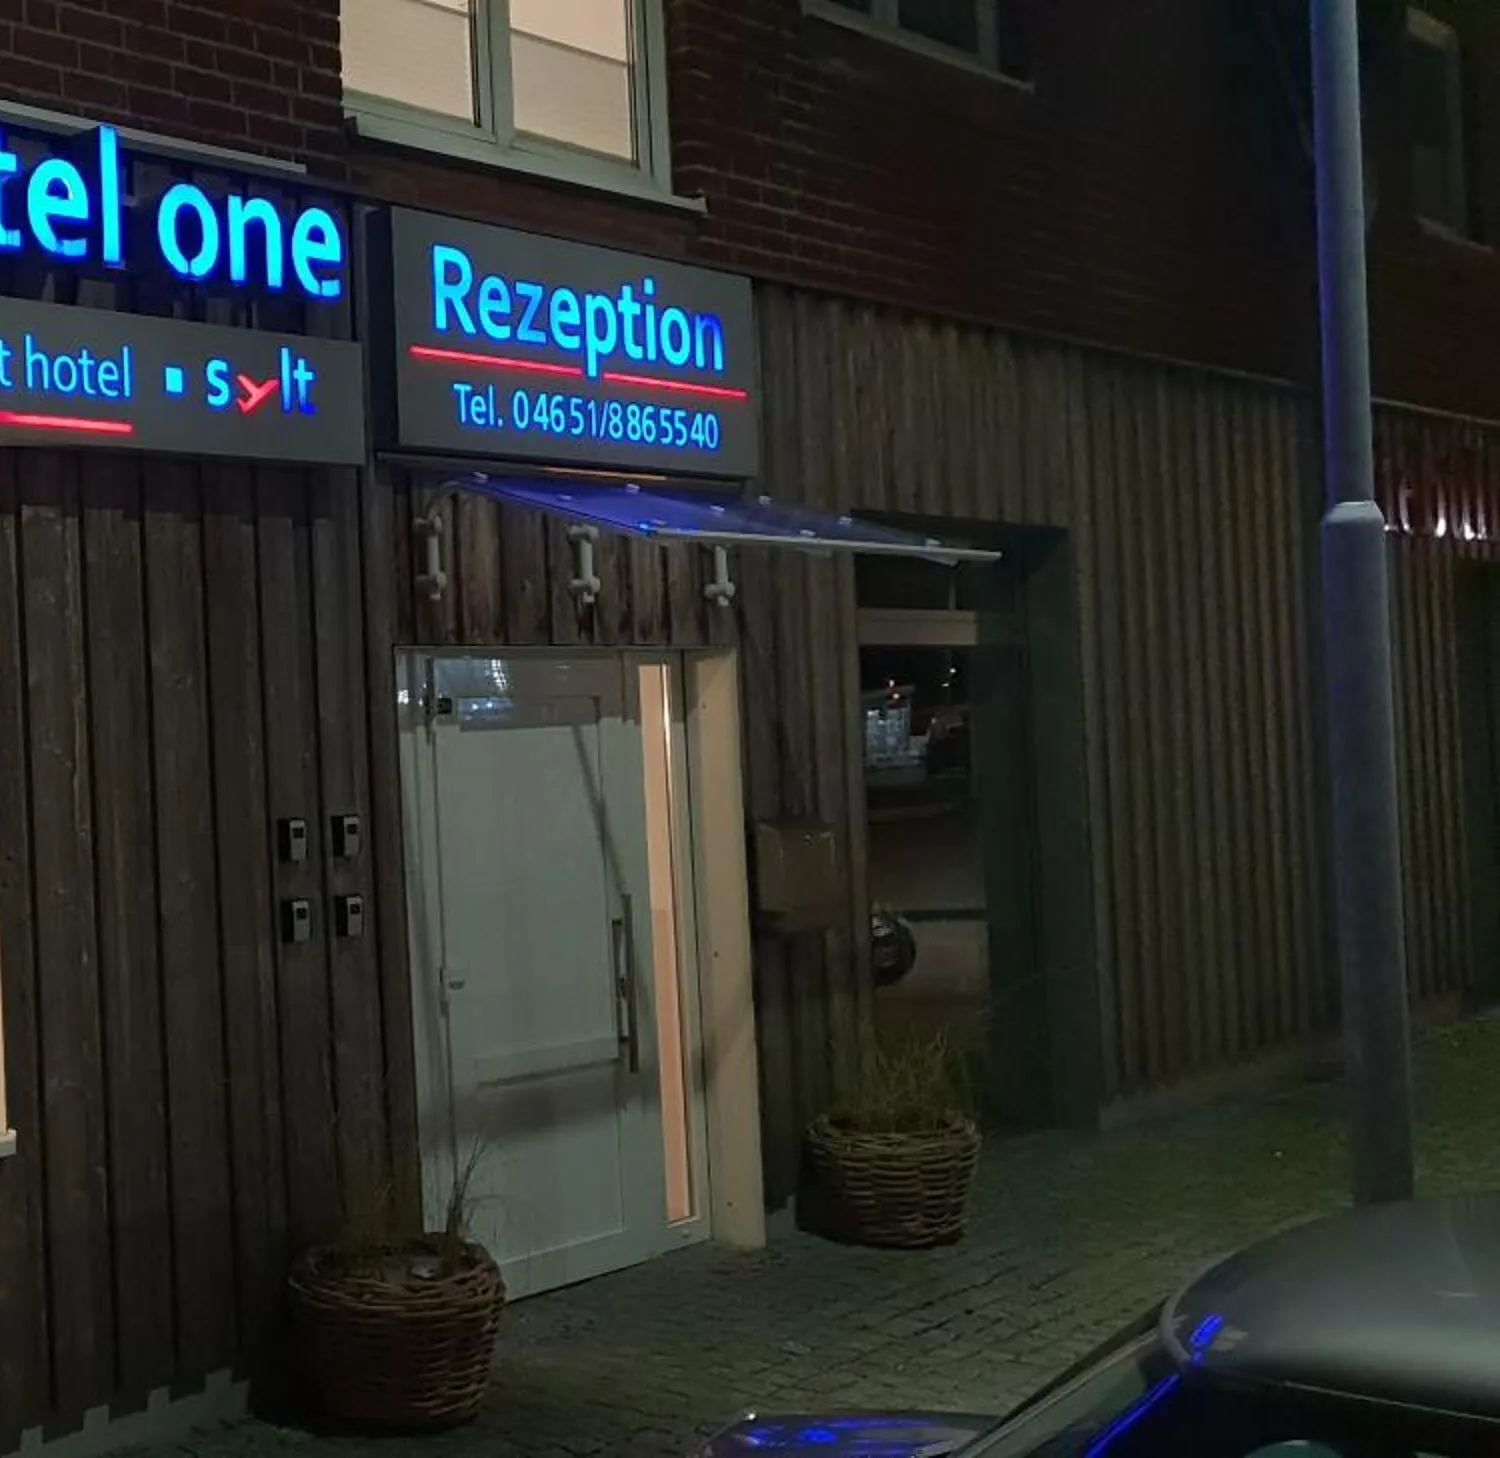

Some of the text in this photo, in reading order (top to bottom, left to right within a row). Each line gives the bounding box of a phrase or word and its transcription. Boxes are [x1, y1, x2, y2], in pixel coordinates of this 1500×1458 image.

[158, 183, 343, 298] one
[432, 244, 725, 378] Rezeption
[25, 333, 132, 398] hotel
[205, 347, 318, 415] sylt
[452, 382, 720, 450] Tel. 04651/8865540
